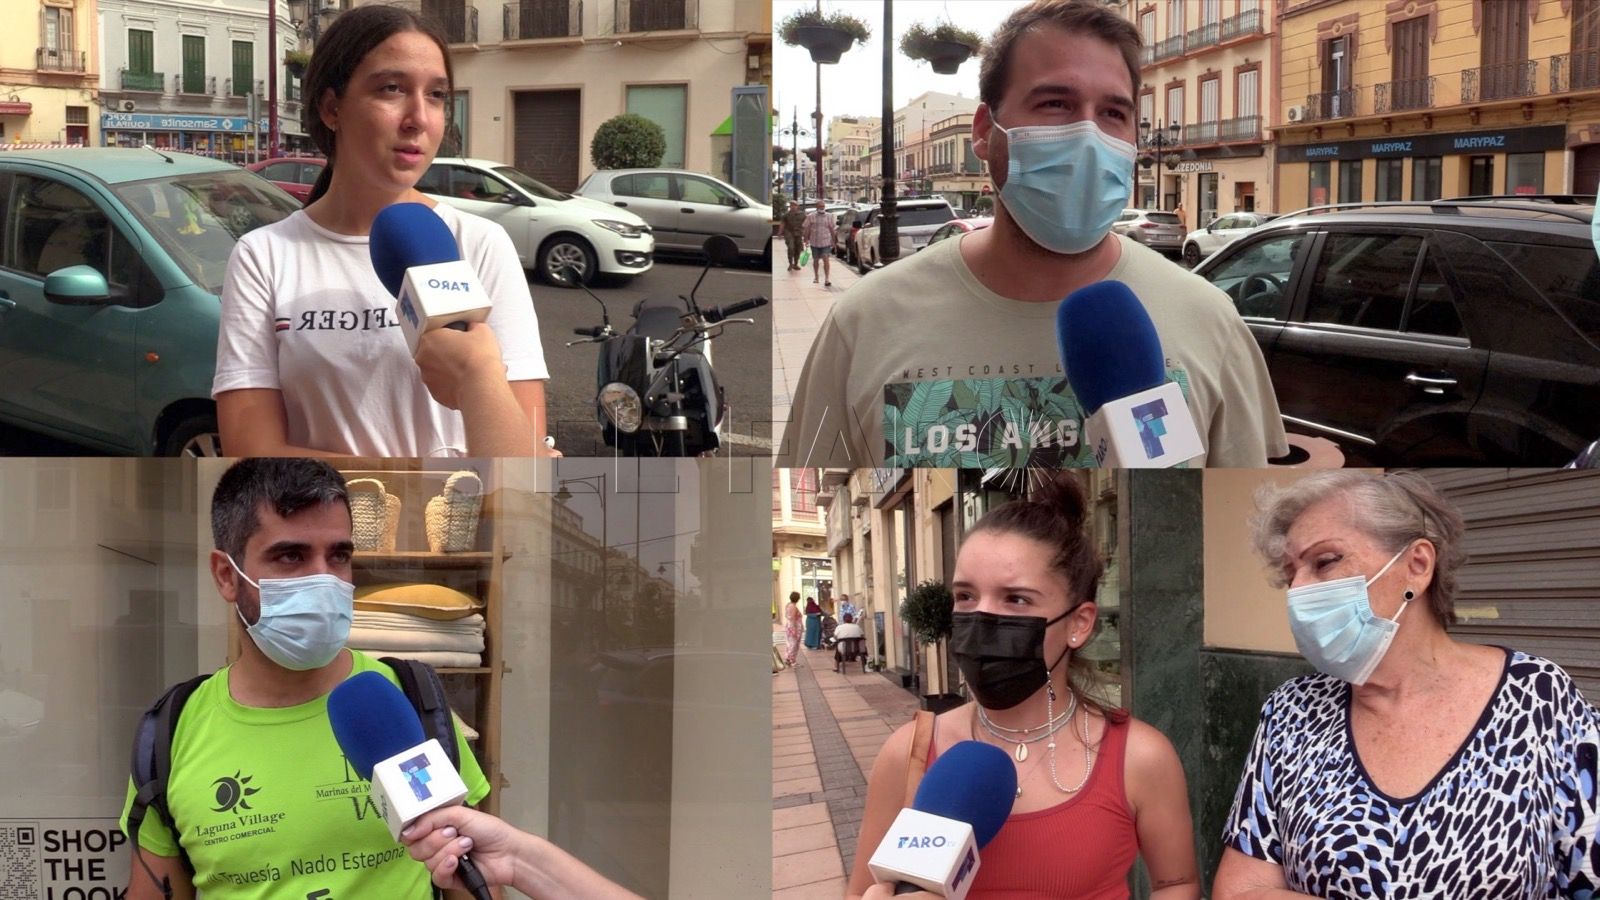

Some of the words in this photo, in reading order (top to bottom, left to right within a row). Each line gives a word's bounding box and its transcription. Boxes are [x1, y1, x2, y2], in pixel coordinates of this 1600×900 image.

[1371, 142, 1412, 153] MARYPAZ
[1454, 136, 1505, 149] MARYPAZ
[1306, 147, 1339, 156] MARYPAZ
[1174, 161, 1213, 173] LZEDONIA
[903, 366, 953, 379] WEST
[968, 364, 1034, 376] COAST
[904, 423, 977, 455] LOS
[315, 787, 350, 799] Marinas
[351, 784, 362, 795] del
[195, 821, 236, 838] Laguna
[238, 811, 286, 826] Village
[43, 829, 127, 852] SHOP
[204, 836, 229, 847] CENTRO
[230, 827, 276, 841] COMERCIAL
[897, 835, 946, 849] FARO
[44, 858, 106, 881] THE
[218, 862, 281, 885] Travesía
[291, 857, 337, 876] Nado
[343, 845, 405, 871] Estepona
